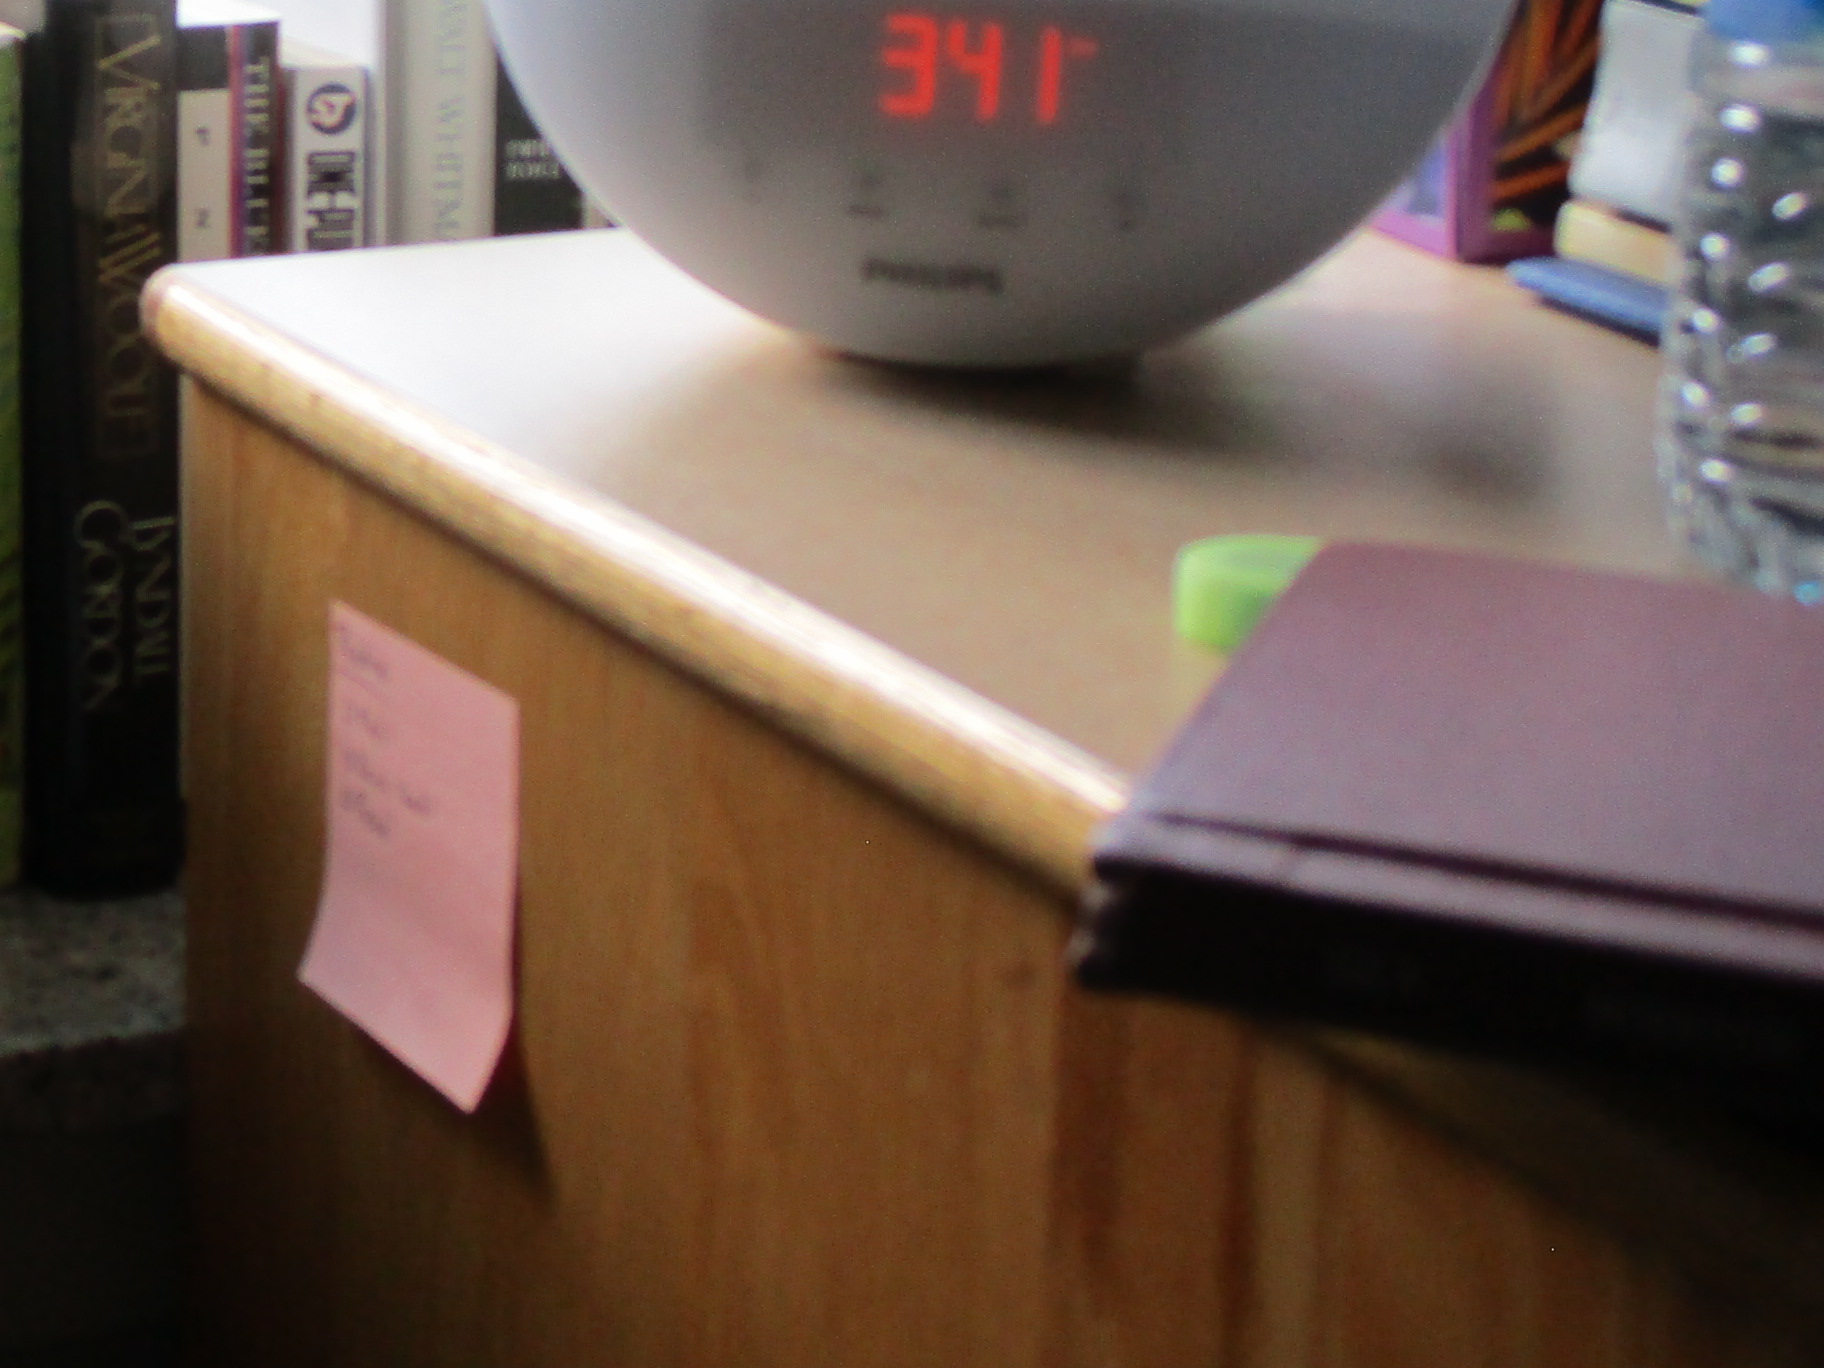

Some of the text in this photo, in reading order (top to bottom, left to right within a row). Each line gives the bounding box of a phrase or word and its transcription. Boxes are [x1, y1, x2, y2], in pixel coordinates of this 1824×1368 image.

[244, 58, 272, 136] THE
[97, 34, 162, 435] VIRGINIA WOOLF
[76, 499, 128, 713] GORDON
[121, 516, 176, 686] LYNDALL
